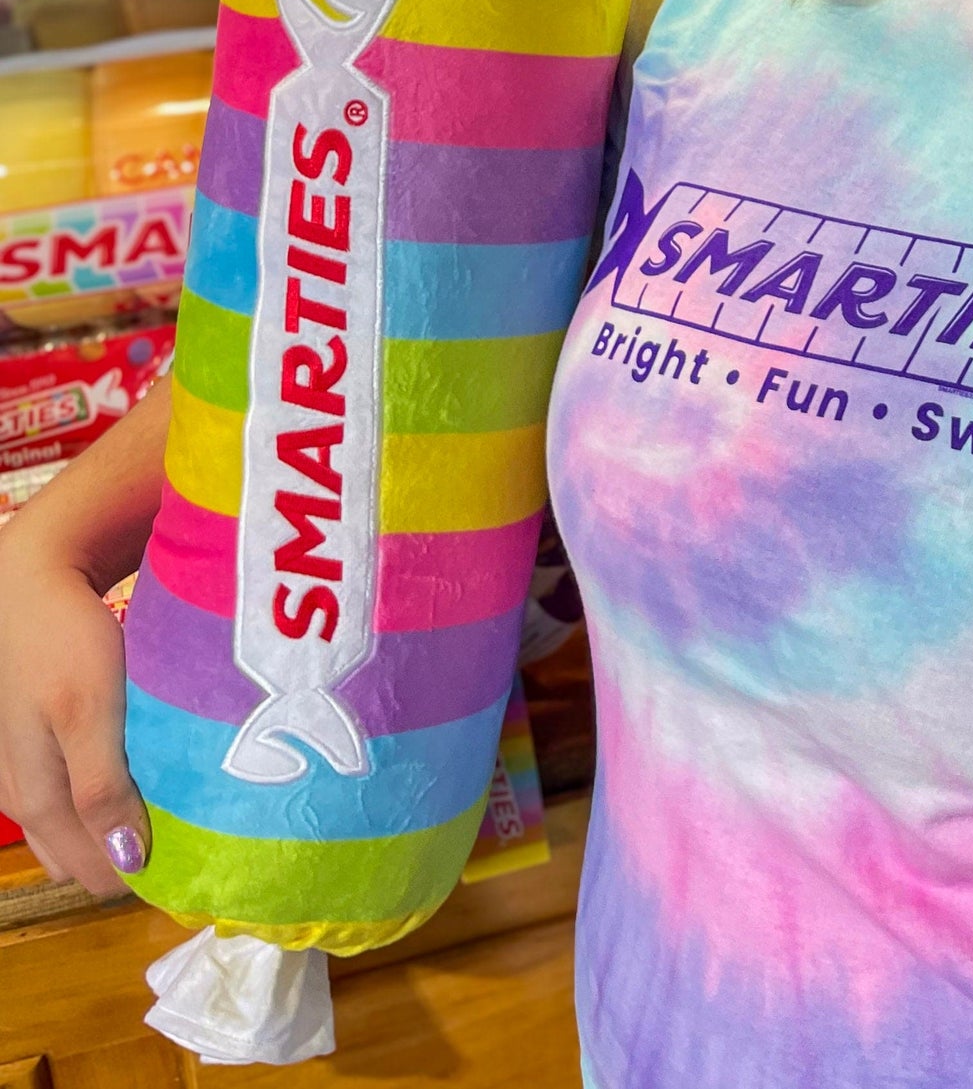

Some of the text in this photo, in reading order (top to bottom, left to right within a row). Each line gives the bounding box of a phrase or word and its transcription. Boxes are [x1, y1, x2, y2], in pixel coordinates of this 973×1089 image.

[0, 218, 179, 284] SMA
[271, 121, 353, 644] SMARTIES
[591, 321, 710, 383] Bright
[756, 366, 850, 422] Fun
